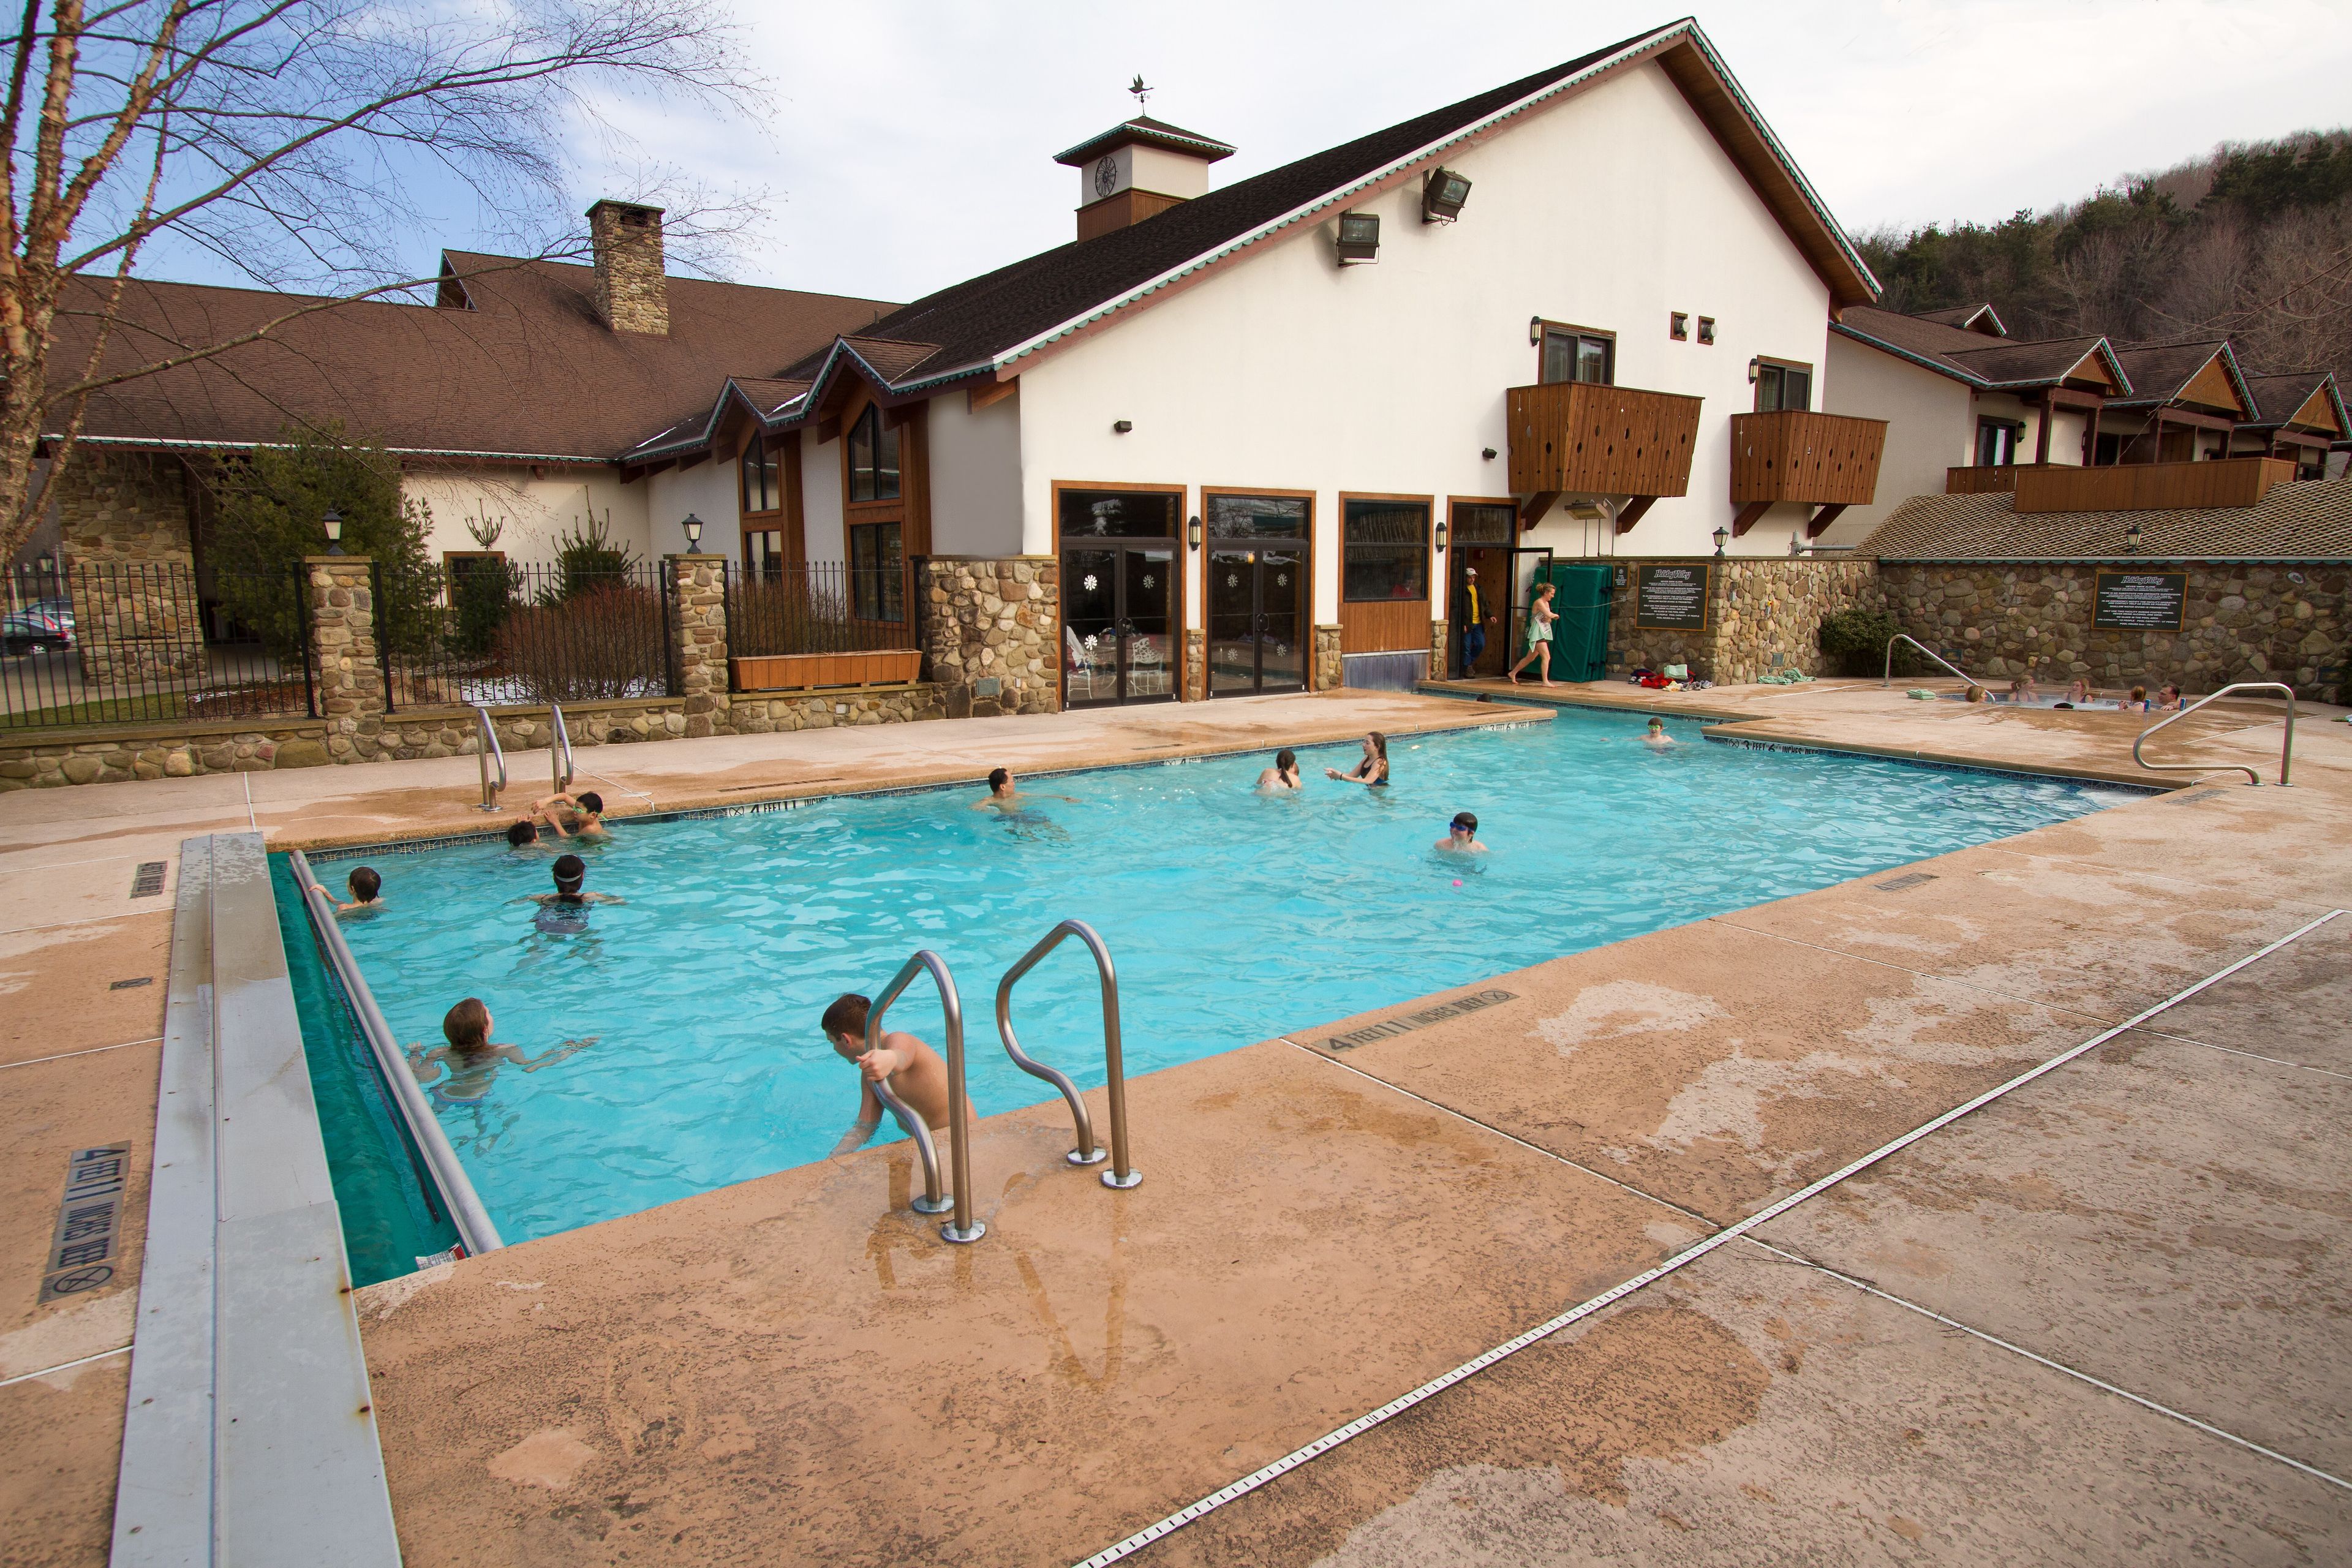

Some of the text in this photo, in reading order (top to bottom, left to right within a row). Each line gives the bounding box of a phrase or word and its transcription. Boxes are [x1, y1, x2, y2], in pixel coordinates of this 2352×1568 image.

[1654, 569, 1691, 579] Holiday Valley
[2120, 576, 2164, 586] Holiday Valley
[1742, 740, 1750, 750] 3
[1752, 742, 1766, 751] FEET
[1768, 743, 1776, 752] 6
[1782, 745, 1802, 755] INCHES
[750, 804, 760, 813] 4
[763, 801, 782, 813] FEET
[1329, 1037, 1355, 1050] 4
[1344, 1027, 1387, 1043] FEET
[1408, 1006, 1460, 1025] INCHES
[1450, 997, 1489, 1011] DEEP
[58, 1149, 127, 1269] 4 FEET 11 INCHES DEEP
